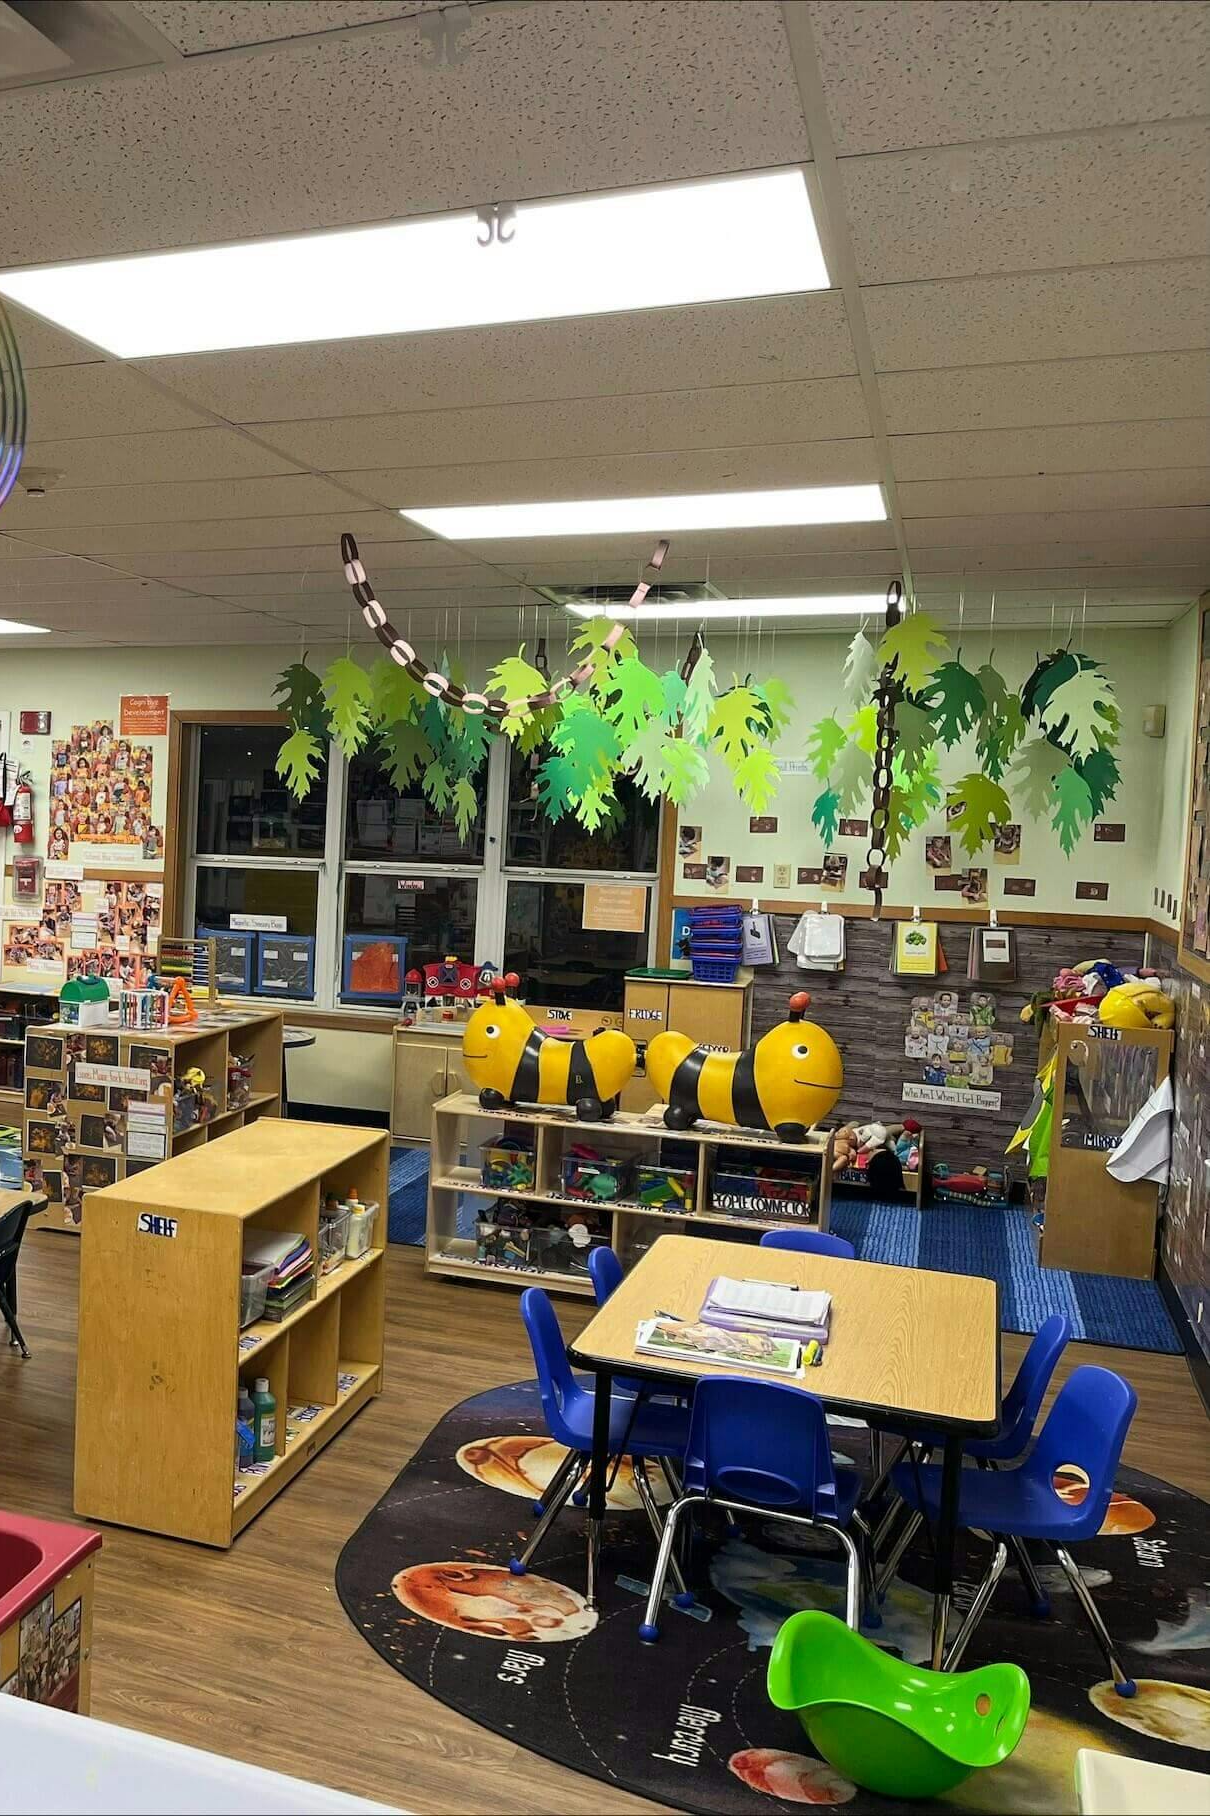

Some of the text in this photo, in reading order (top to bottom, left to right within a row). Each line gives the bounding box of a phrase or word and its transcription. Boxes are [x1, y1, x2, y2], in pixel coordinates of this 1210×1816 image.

[123, 708, 165, 717] Development
[548, 1009, 572, 1021] STOVE
[629, 1009, 662, 1020] FRIDGE
[1089, 1025, 1119, 1040] SHELF
[904, 1087, 918, 1098] Who
[920, 1088, 930, 1099] Am
[936, 1090, 955, 1102] When
[1083, 1133, 1123, 1149] MIRRO
[712, 1192, 750, 1210] PEOPLE
[138, 1213, 179, 1238] SHELF
[1132, 1536, 1170, 1568] Saturn
[497, 1648, 546, 1685] Mars
[652, 1703, 722, 1767] Mercury
